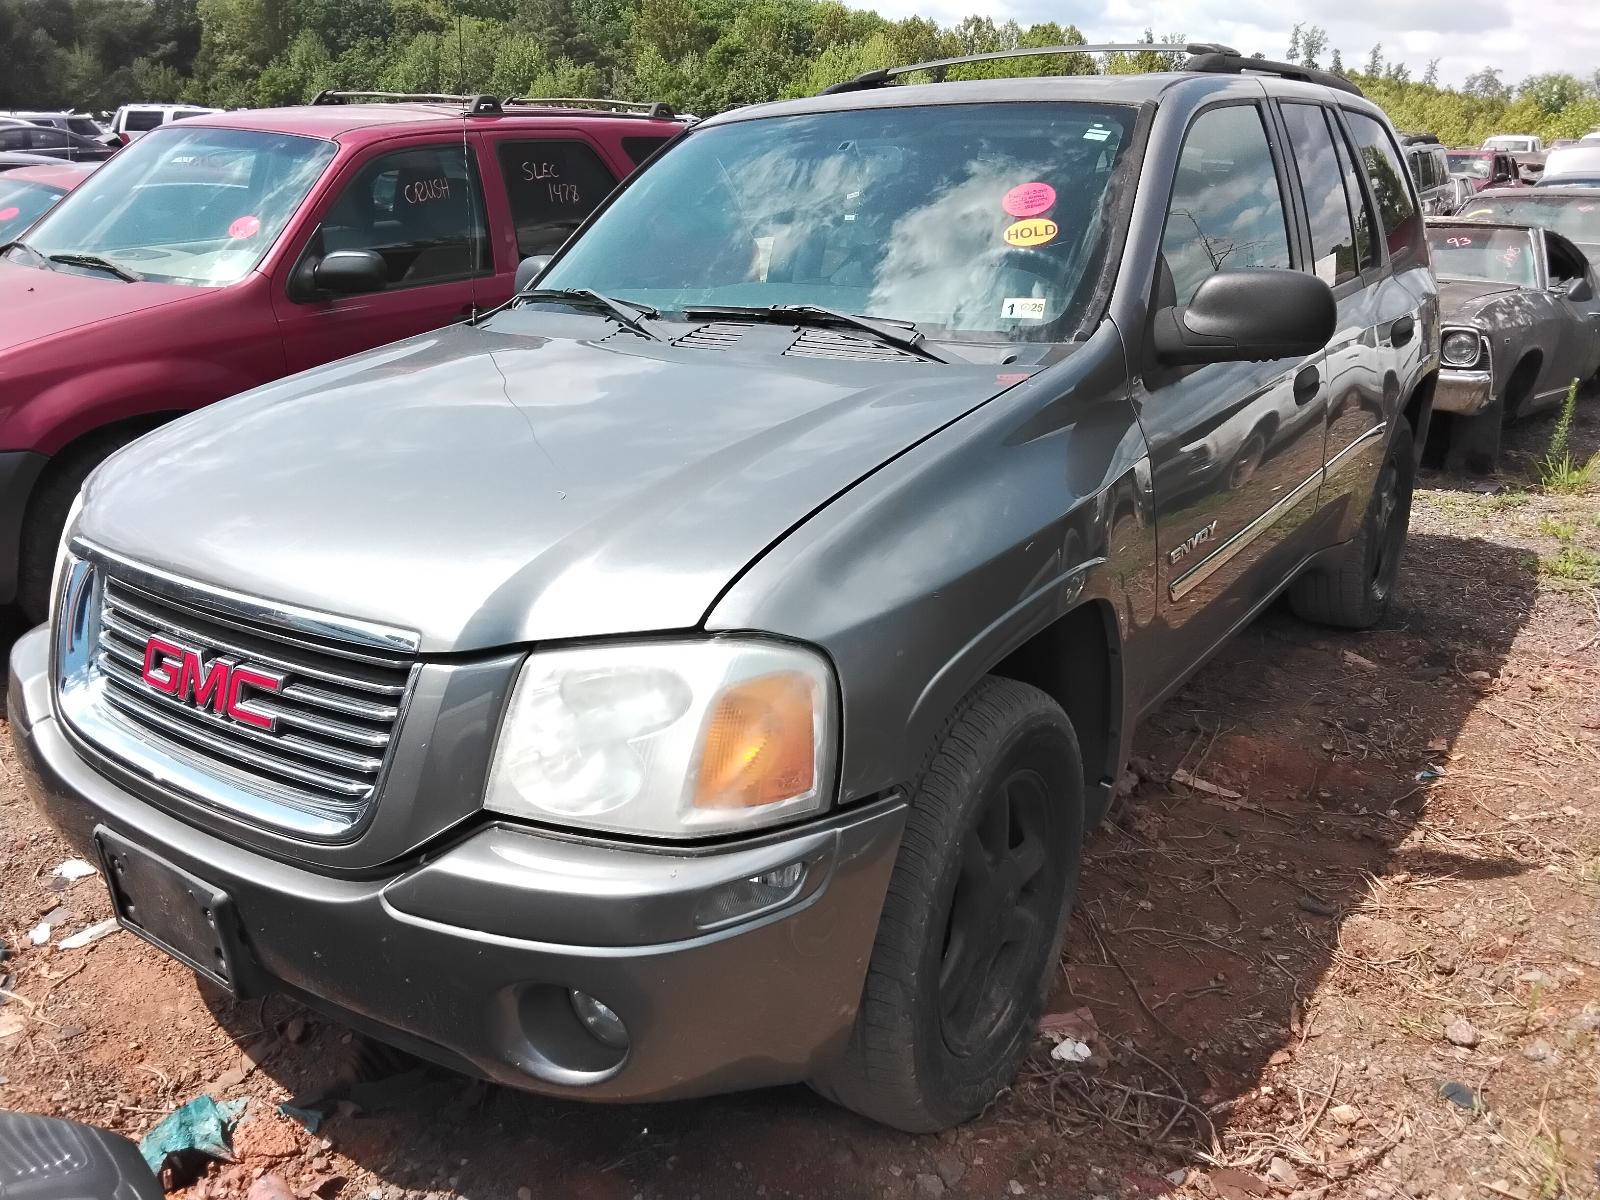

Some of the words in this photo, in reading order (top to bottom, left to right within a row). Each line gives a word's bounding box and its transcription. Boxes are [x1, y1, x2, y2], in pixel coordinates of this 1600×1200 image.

[405, 176, 450, 203] CRUSH
[548, 183, 580, 203] 1478
[1007, 224, 1056, 240] HOLD
[1446, 237, 1472, 247] 93
[1008, 303, 1015, 315] 1
[1030, 303, 1044, 312] 25
[1168, 520, 1217, 565] ENVOY
[142, 634, 284, 732] GMC
